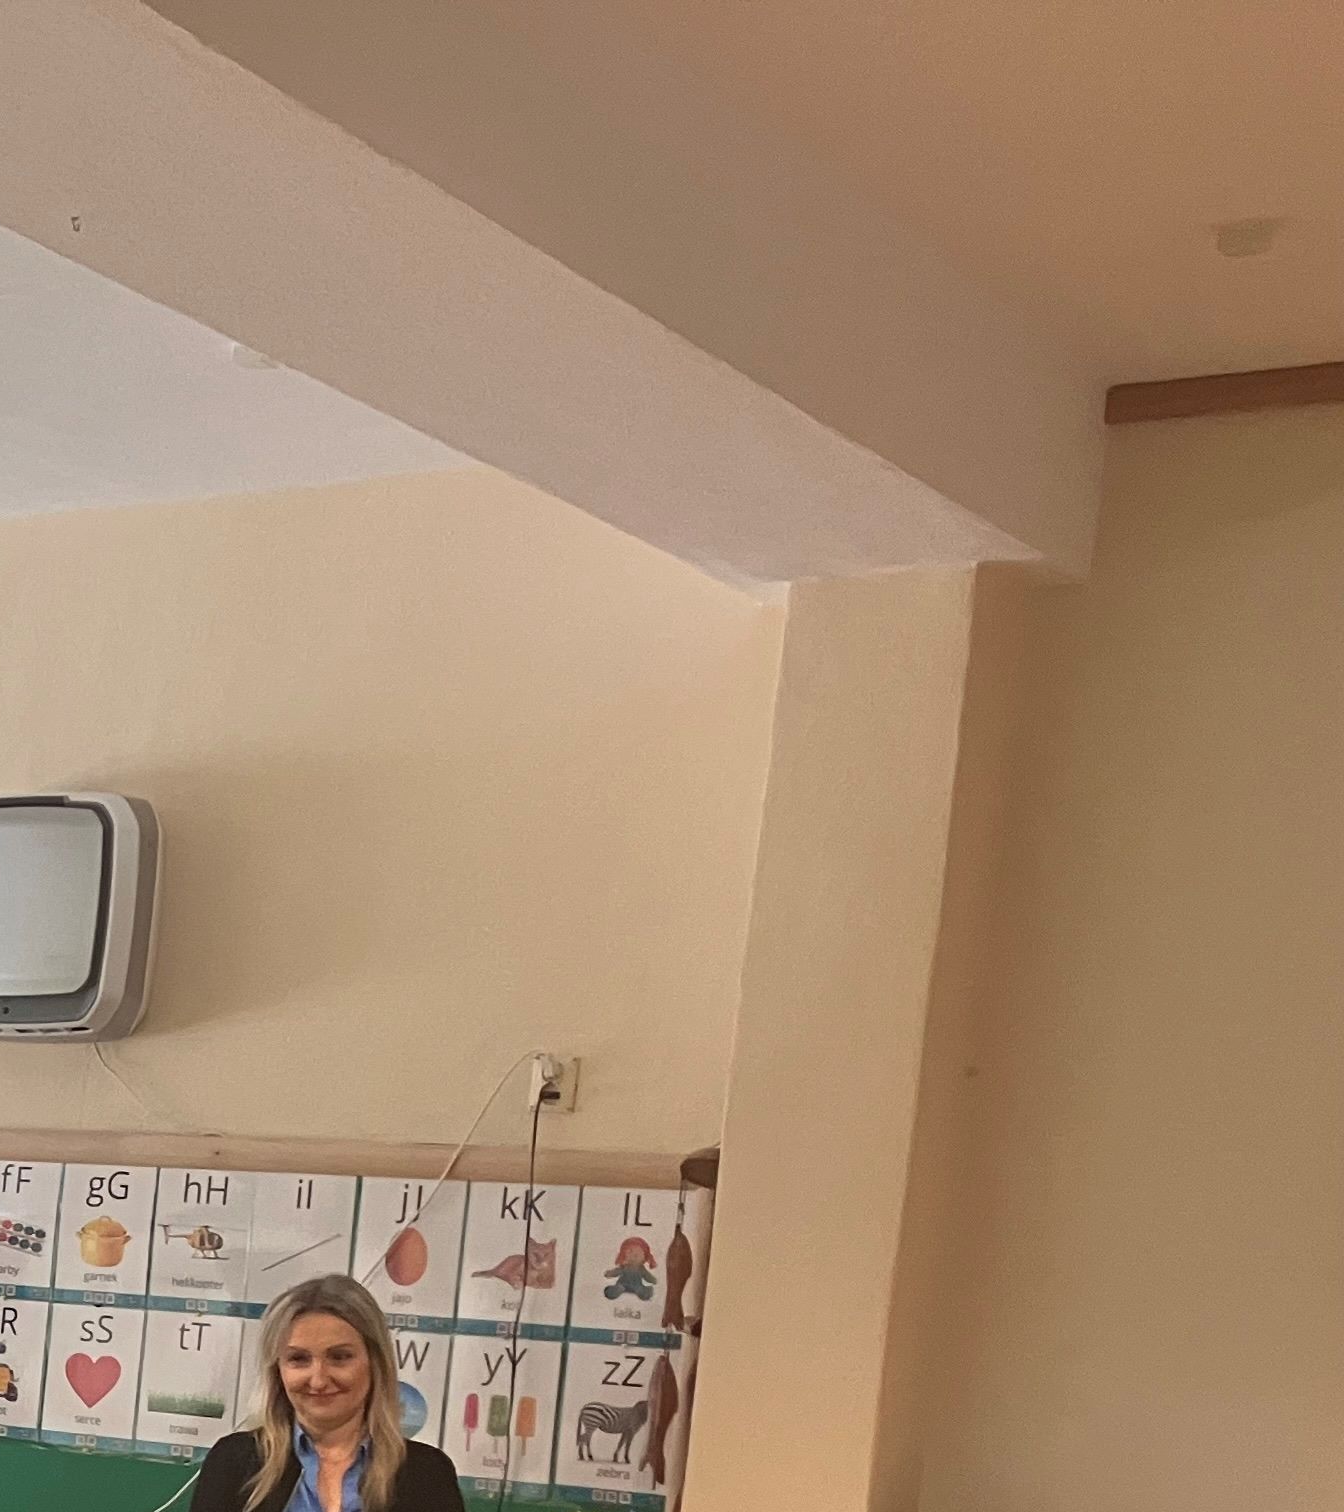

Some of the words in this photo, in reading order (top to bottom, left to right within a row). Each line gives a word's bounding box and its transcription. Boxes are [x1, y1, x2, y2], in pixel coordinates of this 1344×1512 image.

[2, 1164, 33, 1194] fF
[86, 1171, 130, 1208] gG
[183, 1173, 229, 1206] hH
[395, 1183, 424, 1224] jJ
[500, 1186, 546, 1222] kK
[614, 1306, 642, 1320] lalka
[80, 1315, 114, 1344] sS
[179, 1322, 211, 1351] tT
[394, 1339, 430, 1371] W
[481, 1347, 527, 1386] yY
[601, 1355, 645, 1388] zZ
[74, 1415, 101, 1426] serce
[596, 1467, 630, 1480] zebra
